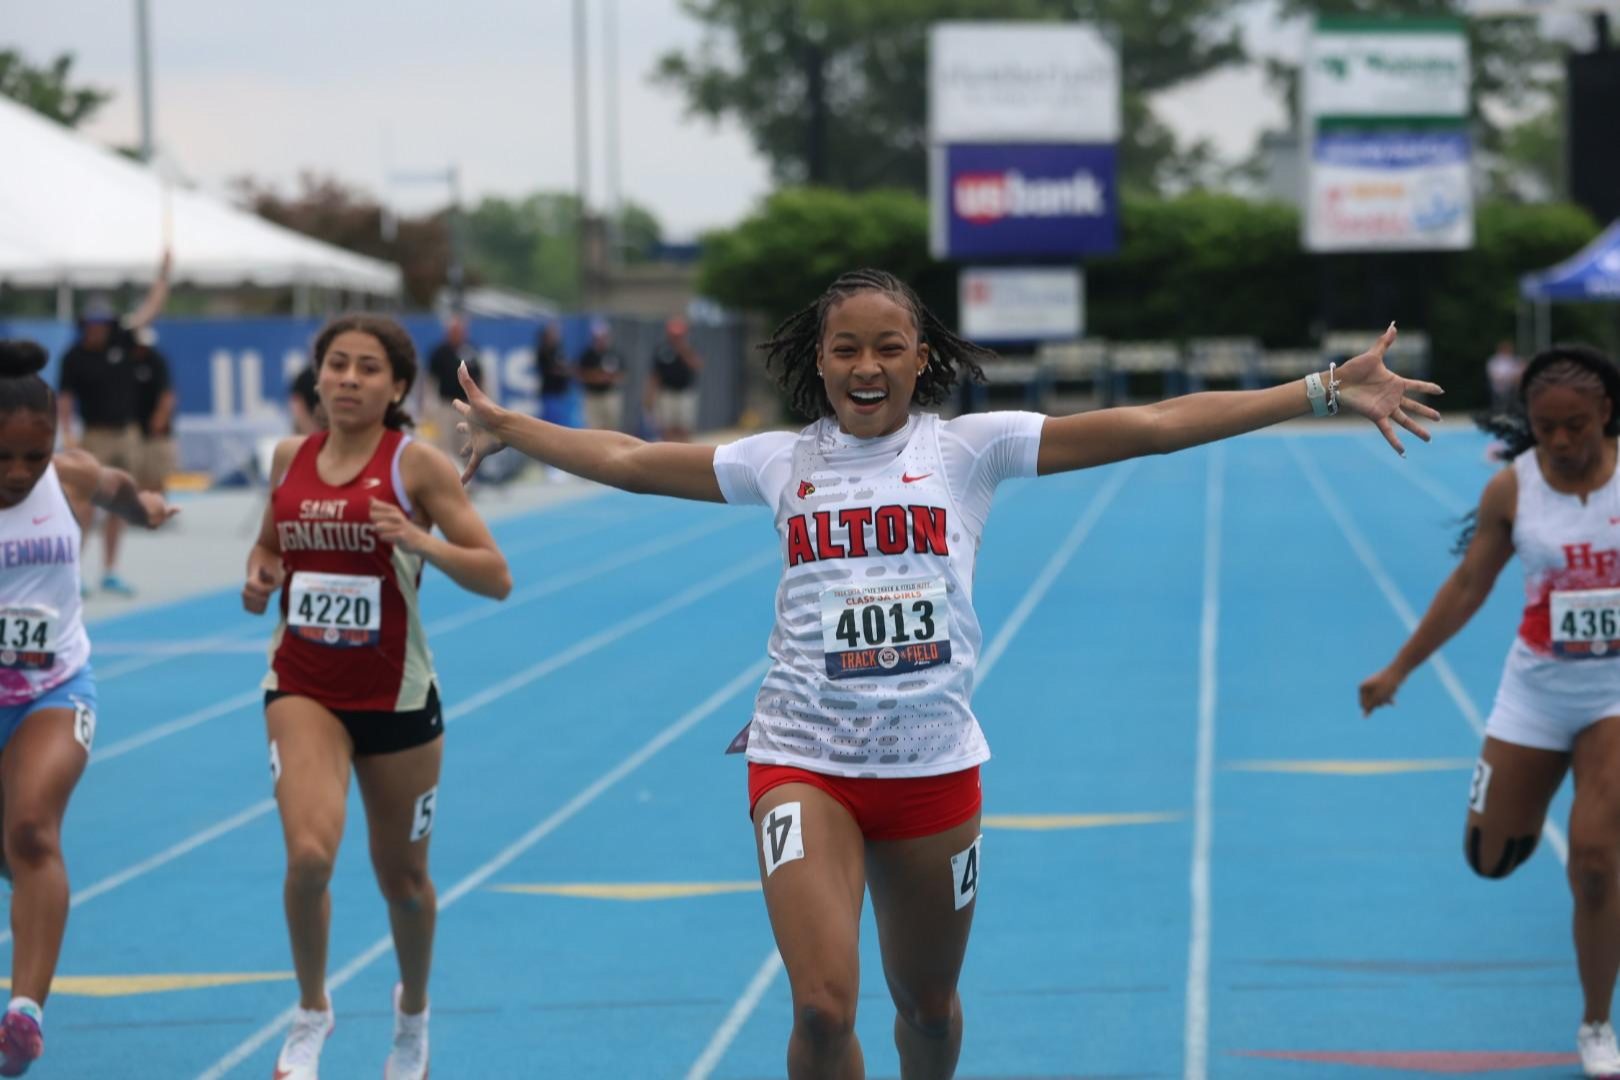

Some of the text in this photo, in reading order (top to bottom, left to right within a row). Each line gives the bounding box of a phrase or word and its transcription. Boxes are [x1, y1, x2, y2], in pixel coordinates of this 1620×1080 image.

[300, 499, 348, 519] SAINT
[277, 521, 376, 552] IGNATIUS
[788, 504, 949, 567] ALTON
[298, 593, 371, 626] 4220
[846, 595, 876, 606] CLASS
[835, 600, 936, 647] 4013
[1561, 608, 1620, 638] 436
[841, 649, 877, 669] TRACK
[907, 643, 939, 662] FIELD
[80, 710, 91, 745] 6
[418, 793, 434, 836] 5
[767, 810, 793, 864] 4
[961, 844, 978, 895] 4
